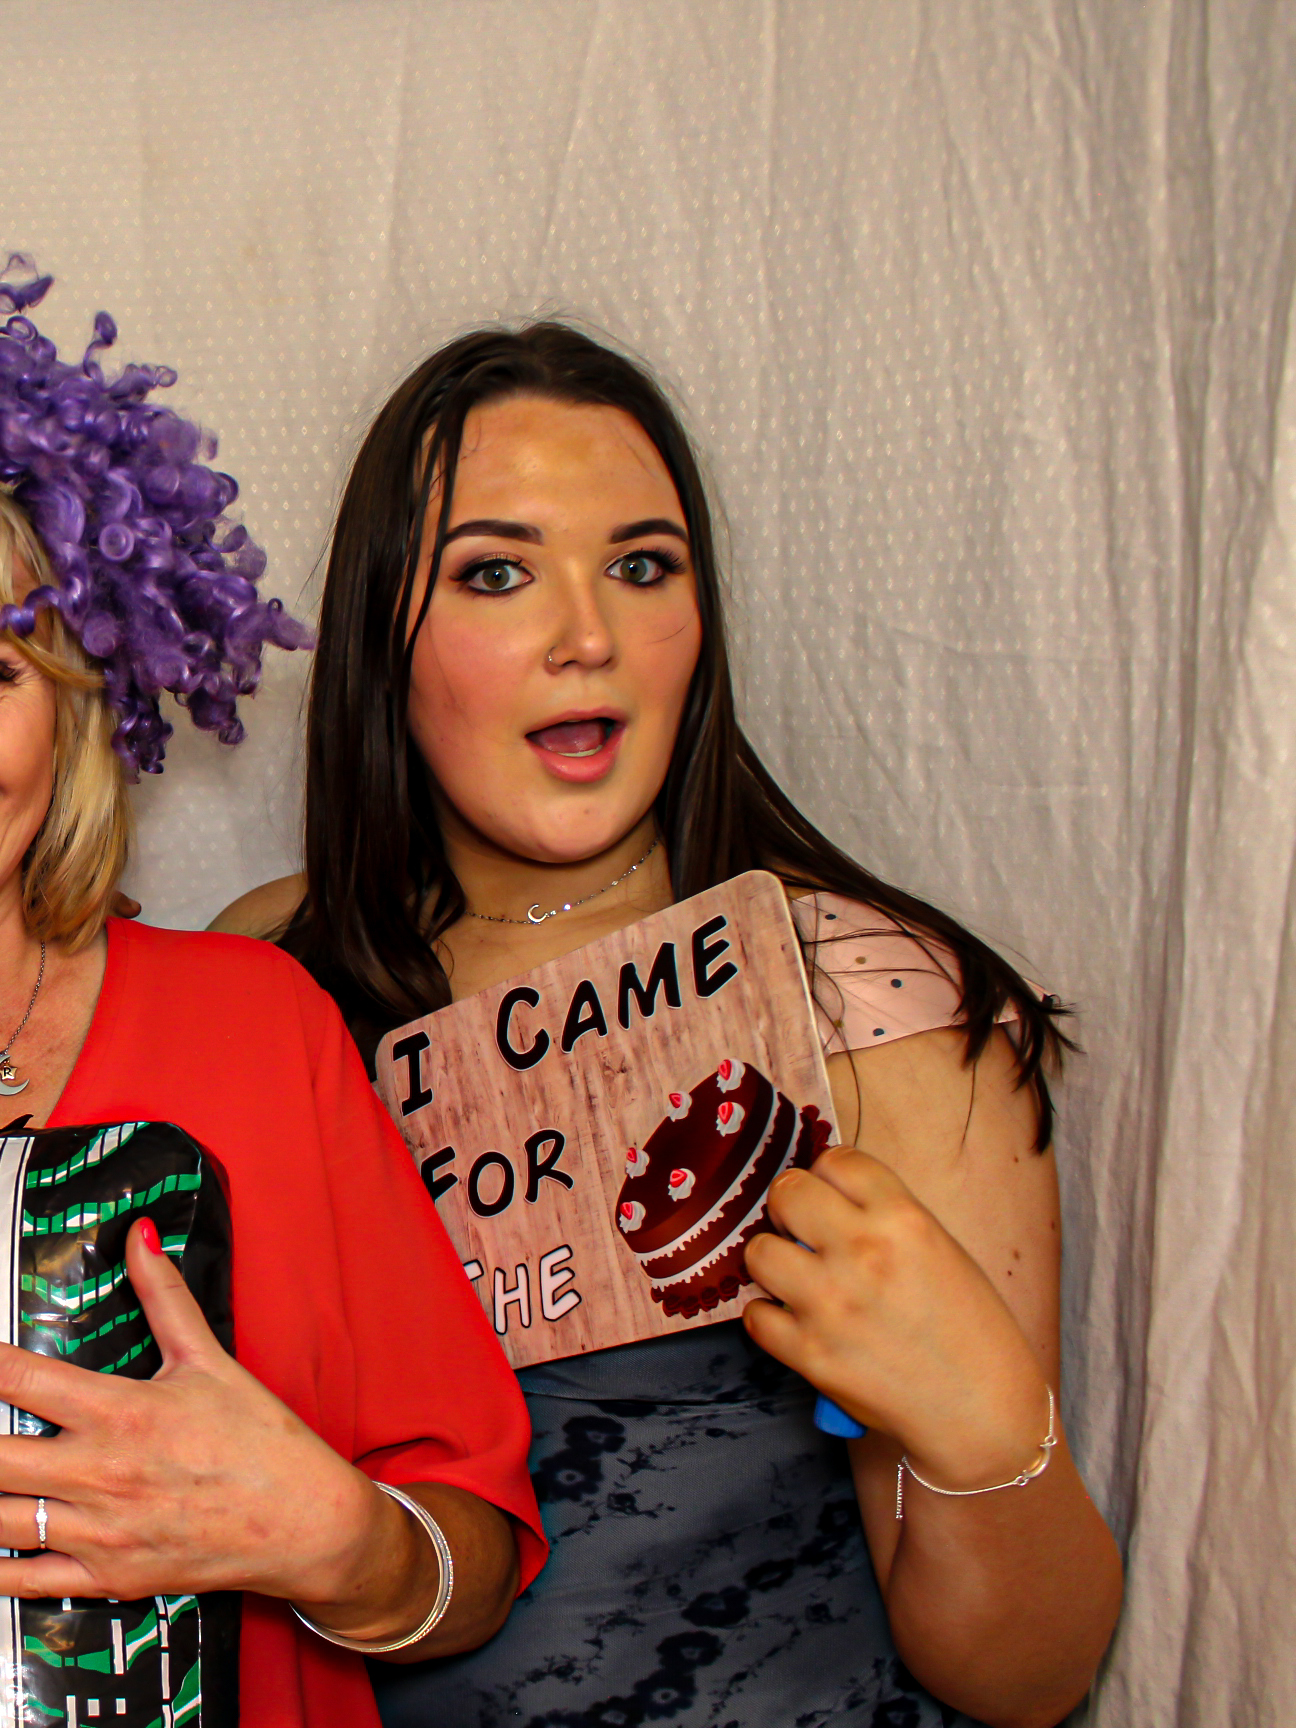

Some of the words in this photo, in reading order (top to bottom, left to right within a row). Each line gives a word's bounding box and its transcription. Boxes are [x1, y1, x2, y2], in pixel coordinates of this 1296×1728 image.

[392, 1030, 433, 1117] I
[496, 914, 738, 1072] CAME
[3, 1067, 13, 1077] R
[420, 1128, 574, 1219] FOR
[462, 1243, 583, 1336] HE
